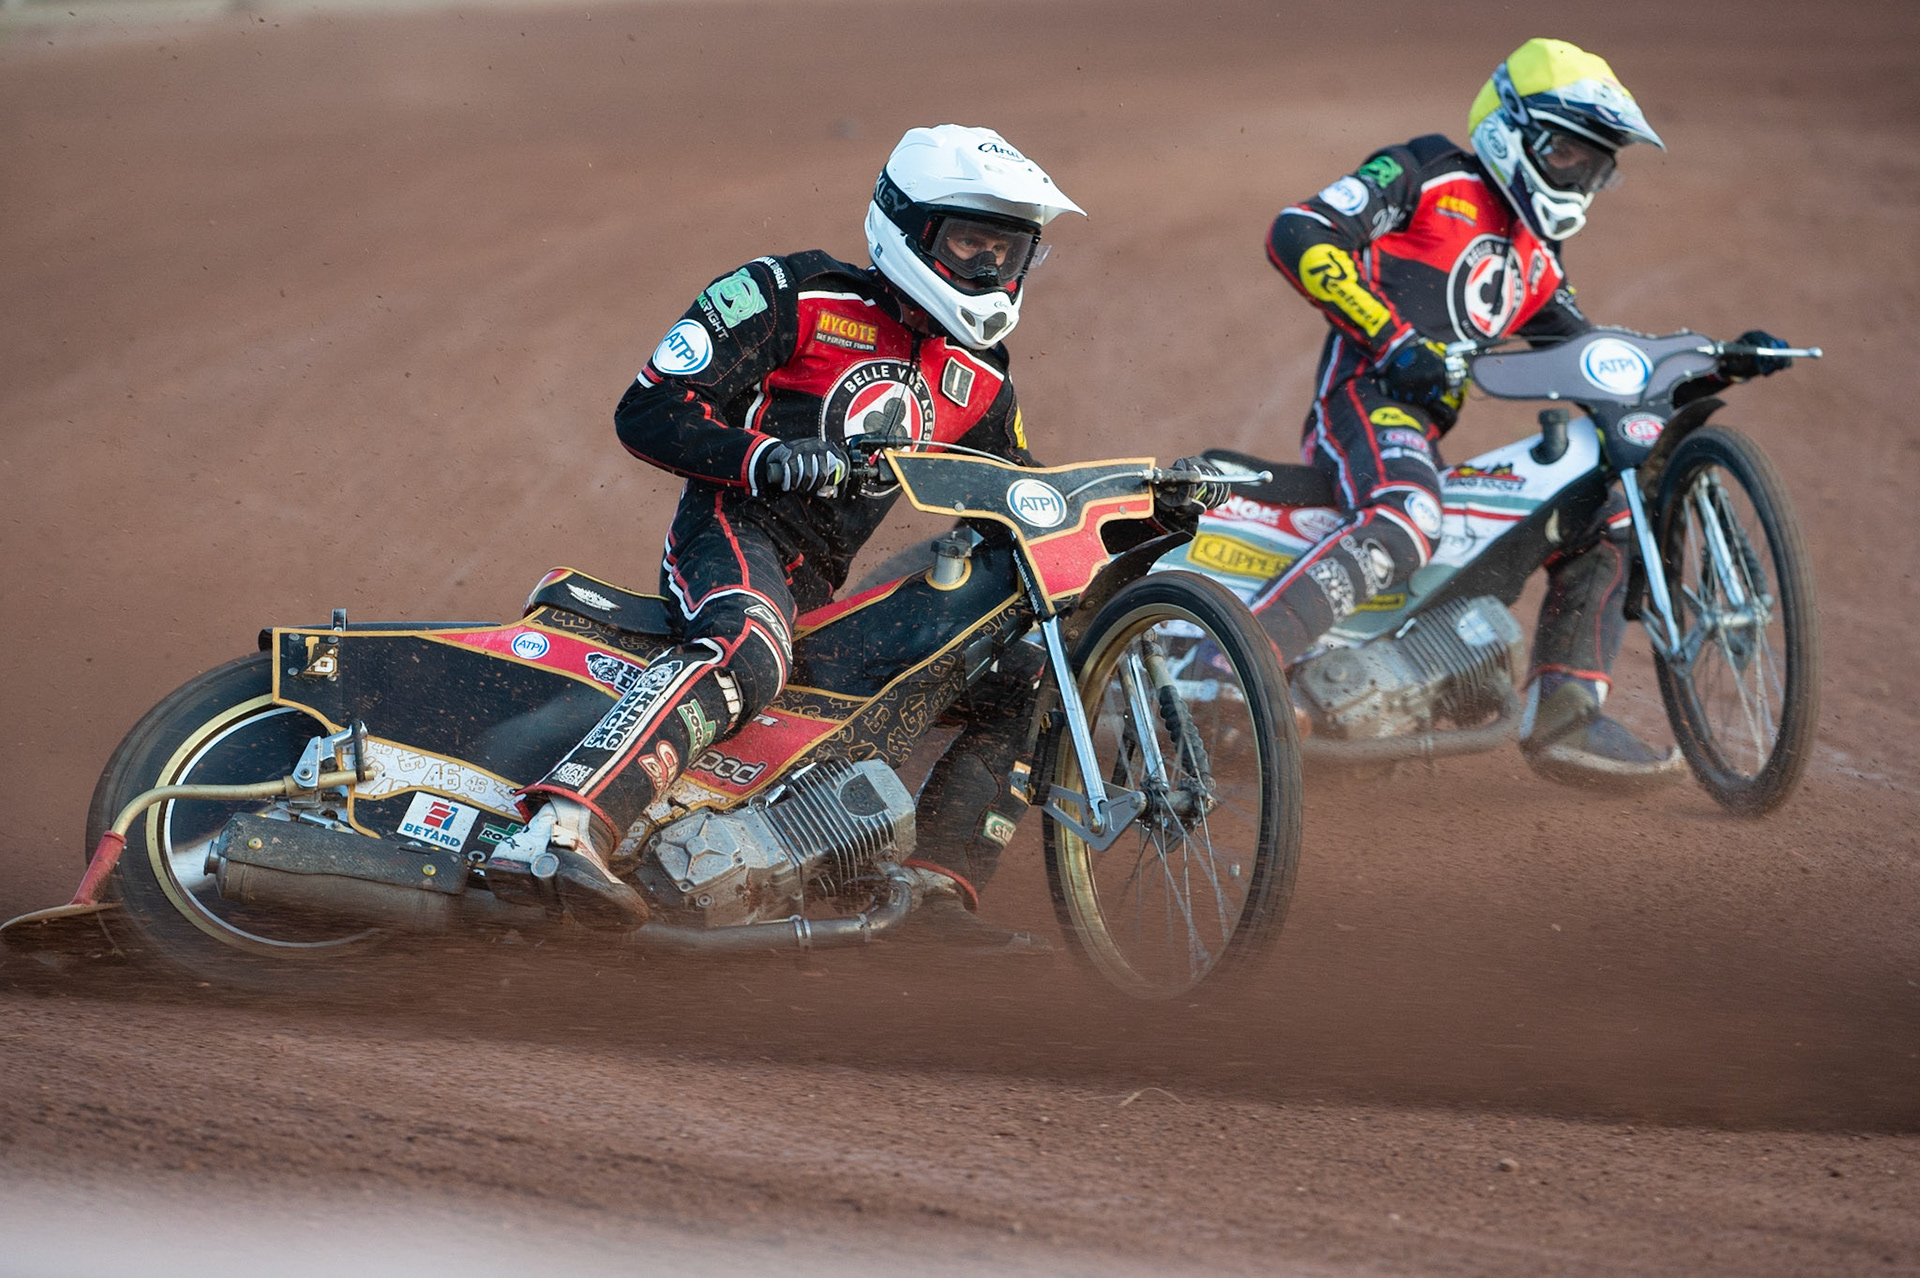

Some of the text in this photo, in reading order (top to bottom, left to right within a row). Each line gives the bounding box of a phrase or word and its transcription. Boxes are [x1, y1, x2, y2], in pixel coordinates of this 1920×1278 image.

[820, 313, 877, 343] HYCOTE
[664, 331, 698, 368] ATPI
[1599, 358, 1637, 374] ATPI
[844, 365, 890, 393] BELLE
[921, 399, 934, 440] ACES
[1019, 496, 1057, 512] ATPI
[517, 639, 543, 652] ATPI
[606, 691, 658, 750] KING
[421, 762, 461, 791] 46
[403, 822, 461, 848] BETARD
